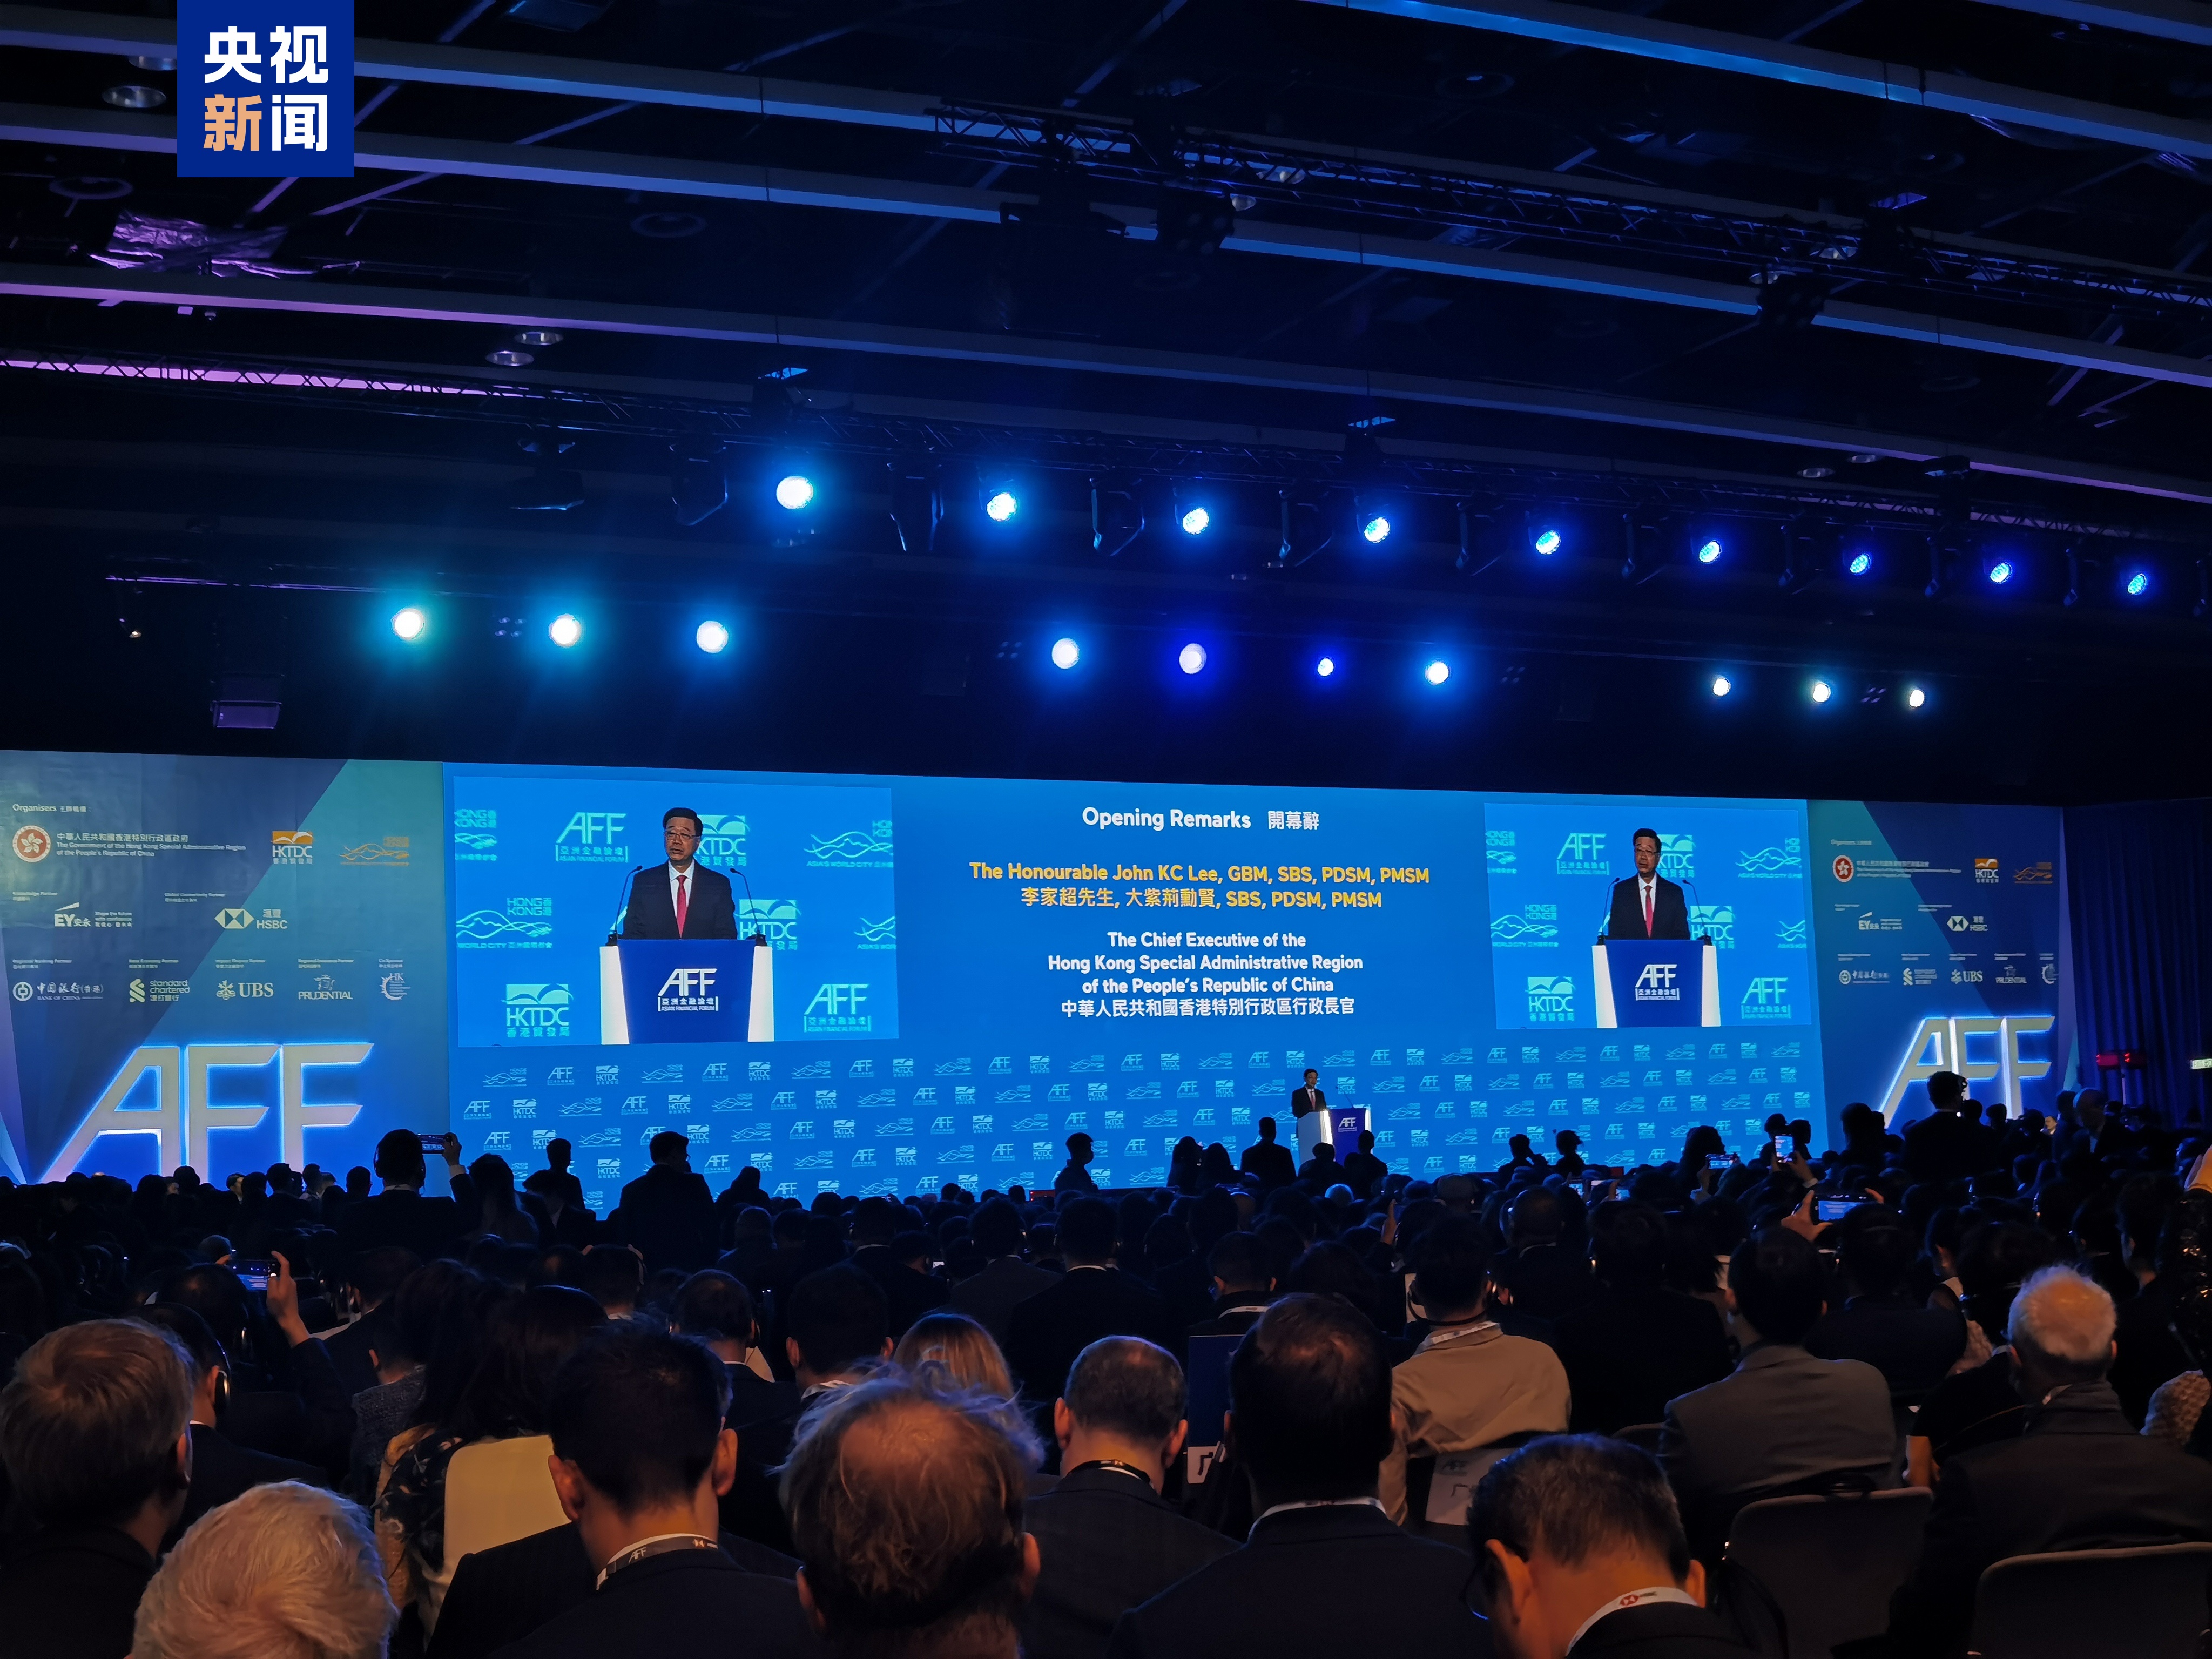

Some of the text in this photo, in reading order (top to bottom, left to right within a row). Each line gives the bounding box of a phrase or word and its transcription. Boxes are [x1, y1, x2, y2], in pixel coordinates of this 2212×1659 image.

[12, 804, 57, 812] Organisers
[1083, 807, 1319, 831] Opening Remarks 開幕辭
[556, 812, 626, 844] AFF
[272, 845, 313, 858] HKTDC
[698, 838, 746, 855] KTDC
[1557, 833, 1607, 860] AFF
[1658, 853, 1694, 868] KTDC
[969, 862, 1429, 885] The Honourable John KC Lee, GBM, SBS, PDSM, PMSM
[507, 898, 542, 906] HONG
[1022, 887, 1120, 908] 李家超先生,
[1226, 891, 1266, 909] SBS,
[1272, 892, 1326, 909] PDSM,
[1332, 892, 1381, 907] PMSM
[507, 907, 542, 916] KONG
[55, 914, 76, 927] EY
[257, 920, 288, 929] HSBC
[1108, 932, 1306, 947] The Chief Executive of the
[1049, 955, 1363, 974] Hong Kong Special Administrative Region
[658, 968, 717, 996] AFF
[1635, 964, 1677, 988] AFF
[1963, 971, 1983, 982] UBS
[238, 982, 274, 997] UBS
[1082, 977, 1333, 996] of the People's Republic of China
[1741, 977, 1788, 1004] AFF
[298, 991, 353, 1000] PRUDENTIAL
[804, 983, 869, 1015] AFF
[1062, 997, 1354, 1017] 中華人民共和國香港特別行政區行政長官
[1529, 996, 1574, 1012] HKTDC
[507, 1007, 569, 1027] HKTDC
[989, 1057, 1010, 1068] AFF
[1122, 1054, 1142, 1064] AFF
[703, 1063, 727, 1074] AFF
[849, 1060, 872, 1071] AFF
[548, 1067, 573, 1079] AFF
[1879, 1016, 2055, 1130] AFF
[1048, 1084, 1069, 1095] AFF
[1177, 1082, 1198, 1091] AFF
[772, 1092, 795, 1103] AFF
[913, 1088, 936, 1098] AFF
[464, 1101, 490, 1113] AFF
[622, 1096, 646, 1108] AFF
[39, 1042, 374, 1185] AFF
[1065, 1113, 1086, 1123] AFF
[1193, 1109, 1214, 1119] AFF
[790, 1122, 813, 1133] AFF
[931, 1117, 954, 1128] AFF
[1339, 1117, 1356, 1127] AFF
[485, 1132, 510, 1144] AFF
[1125, 1139, 1146, 1149] AFF
[852, 1149, 875, 1160] AFF
[992, 1144, 1014, 1154] AFF
[705, 1155, 729, 1166] AFF
[916, 1176, 939, 1187] AFF
[774, 1183, 797, 1195] AFF
[629, 1547, 647, 1563] AFF
